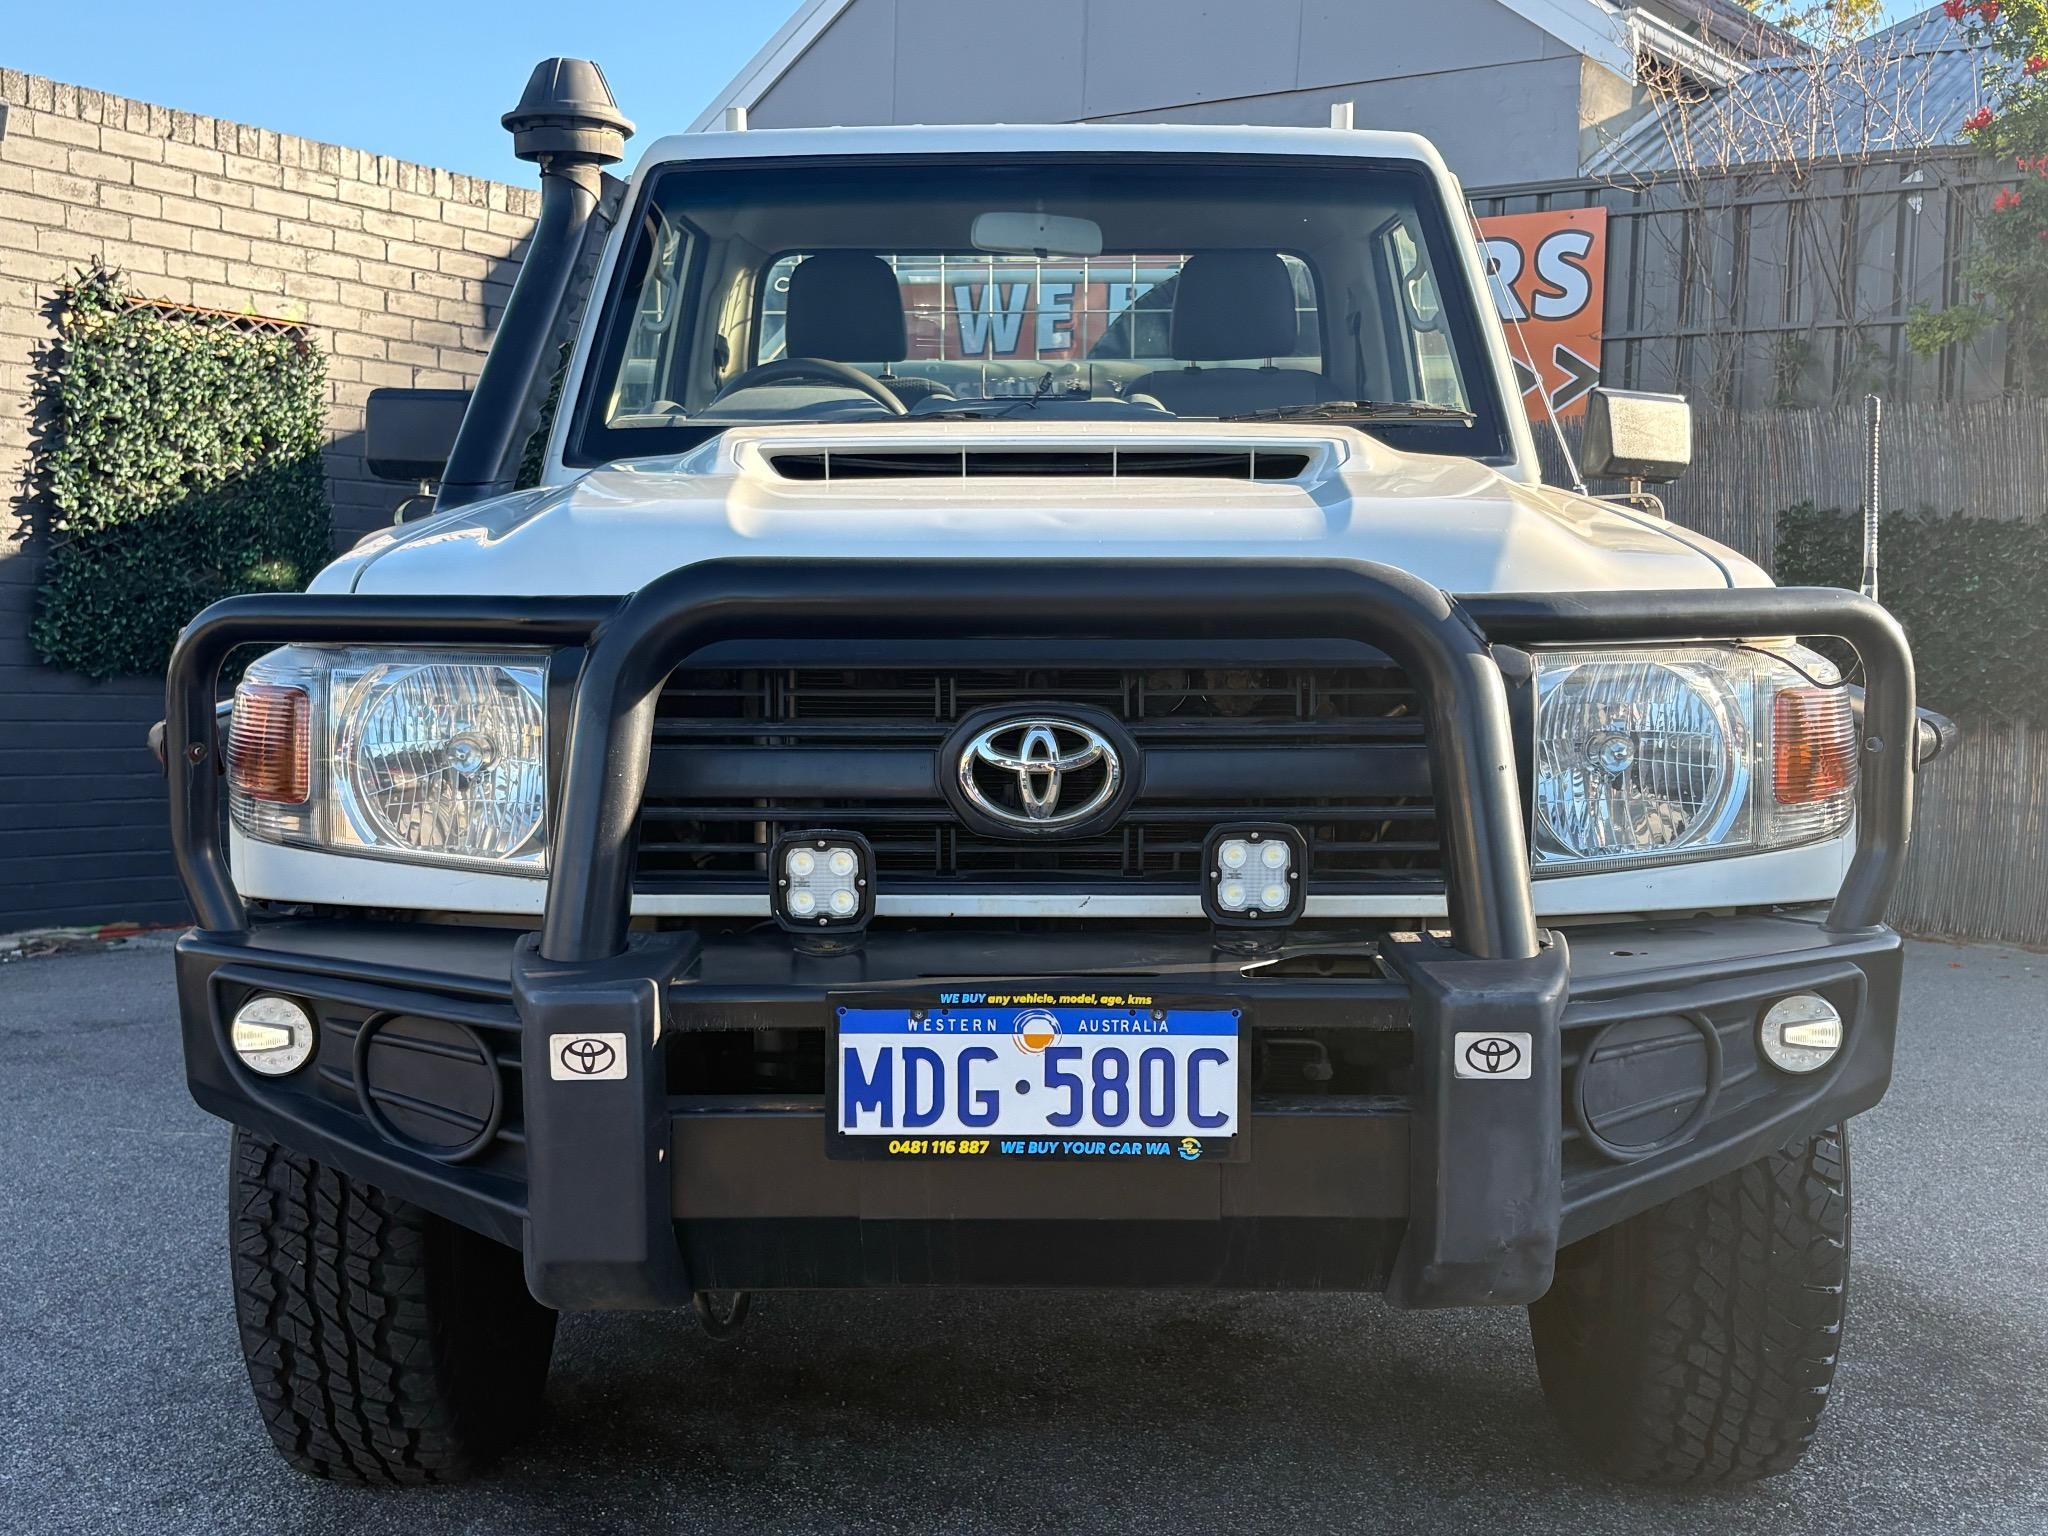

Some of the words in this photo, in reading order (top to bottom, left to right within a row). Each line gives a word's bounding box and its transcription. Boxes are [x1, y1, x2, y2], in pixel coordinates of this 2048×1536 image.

[952, 282, 1075, 355] WE
[940, 993, 960, 1004] WE
[961, 993, 986, 1004] BUY
[987, 995, 1009, 1006] any
[1012, 993, 1056, 1005] vehicle,
[1059, 994, 1098, 1006] model,
[1100, 995, 1125, 1007] age,
[1127, 994, 1153, 1005] kms
[907, 1019, 998, 1033] WESTERN
[1078, 1020, 1169, 1033] AUSTRALIA
[889, 1140, 928, 1154] 0481
[931, 1140, 956, 1154] 116
[958, 1140, 990, 1154] 887
[1000, 1141, 1025, 1154] WE
[1027, 1141, 1059, 1155] BUY
[1062, 1142, 1106, 1155] YOUR
[1108, 1142, 1143, 1155] CAR
[1145, 1142, 1171, 1156] WA
